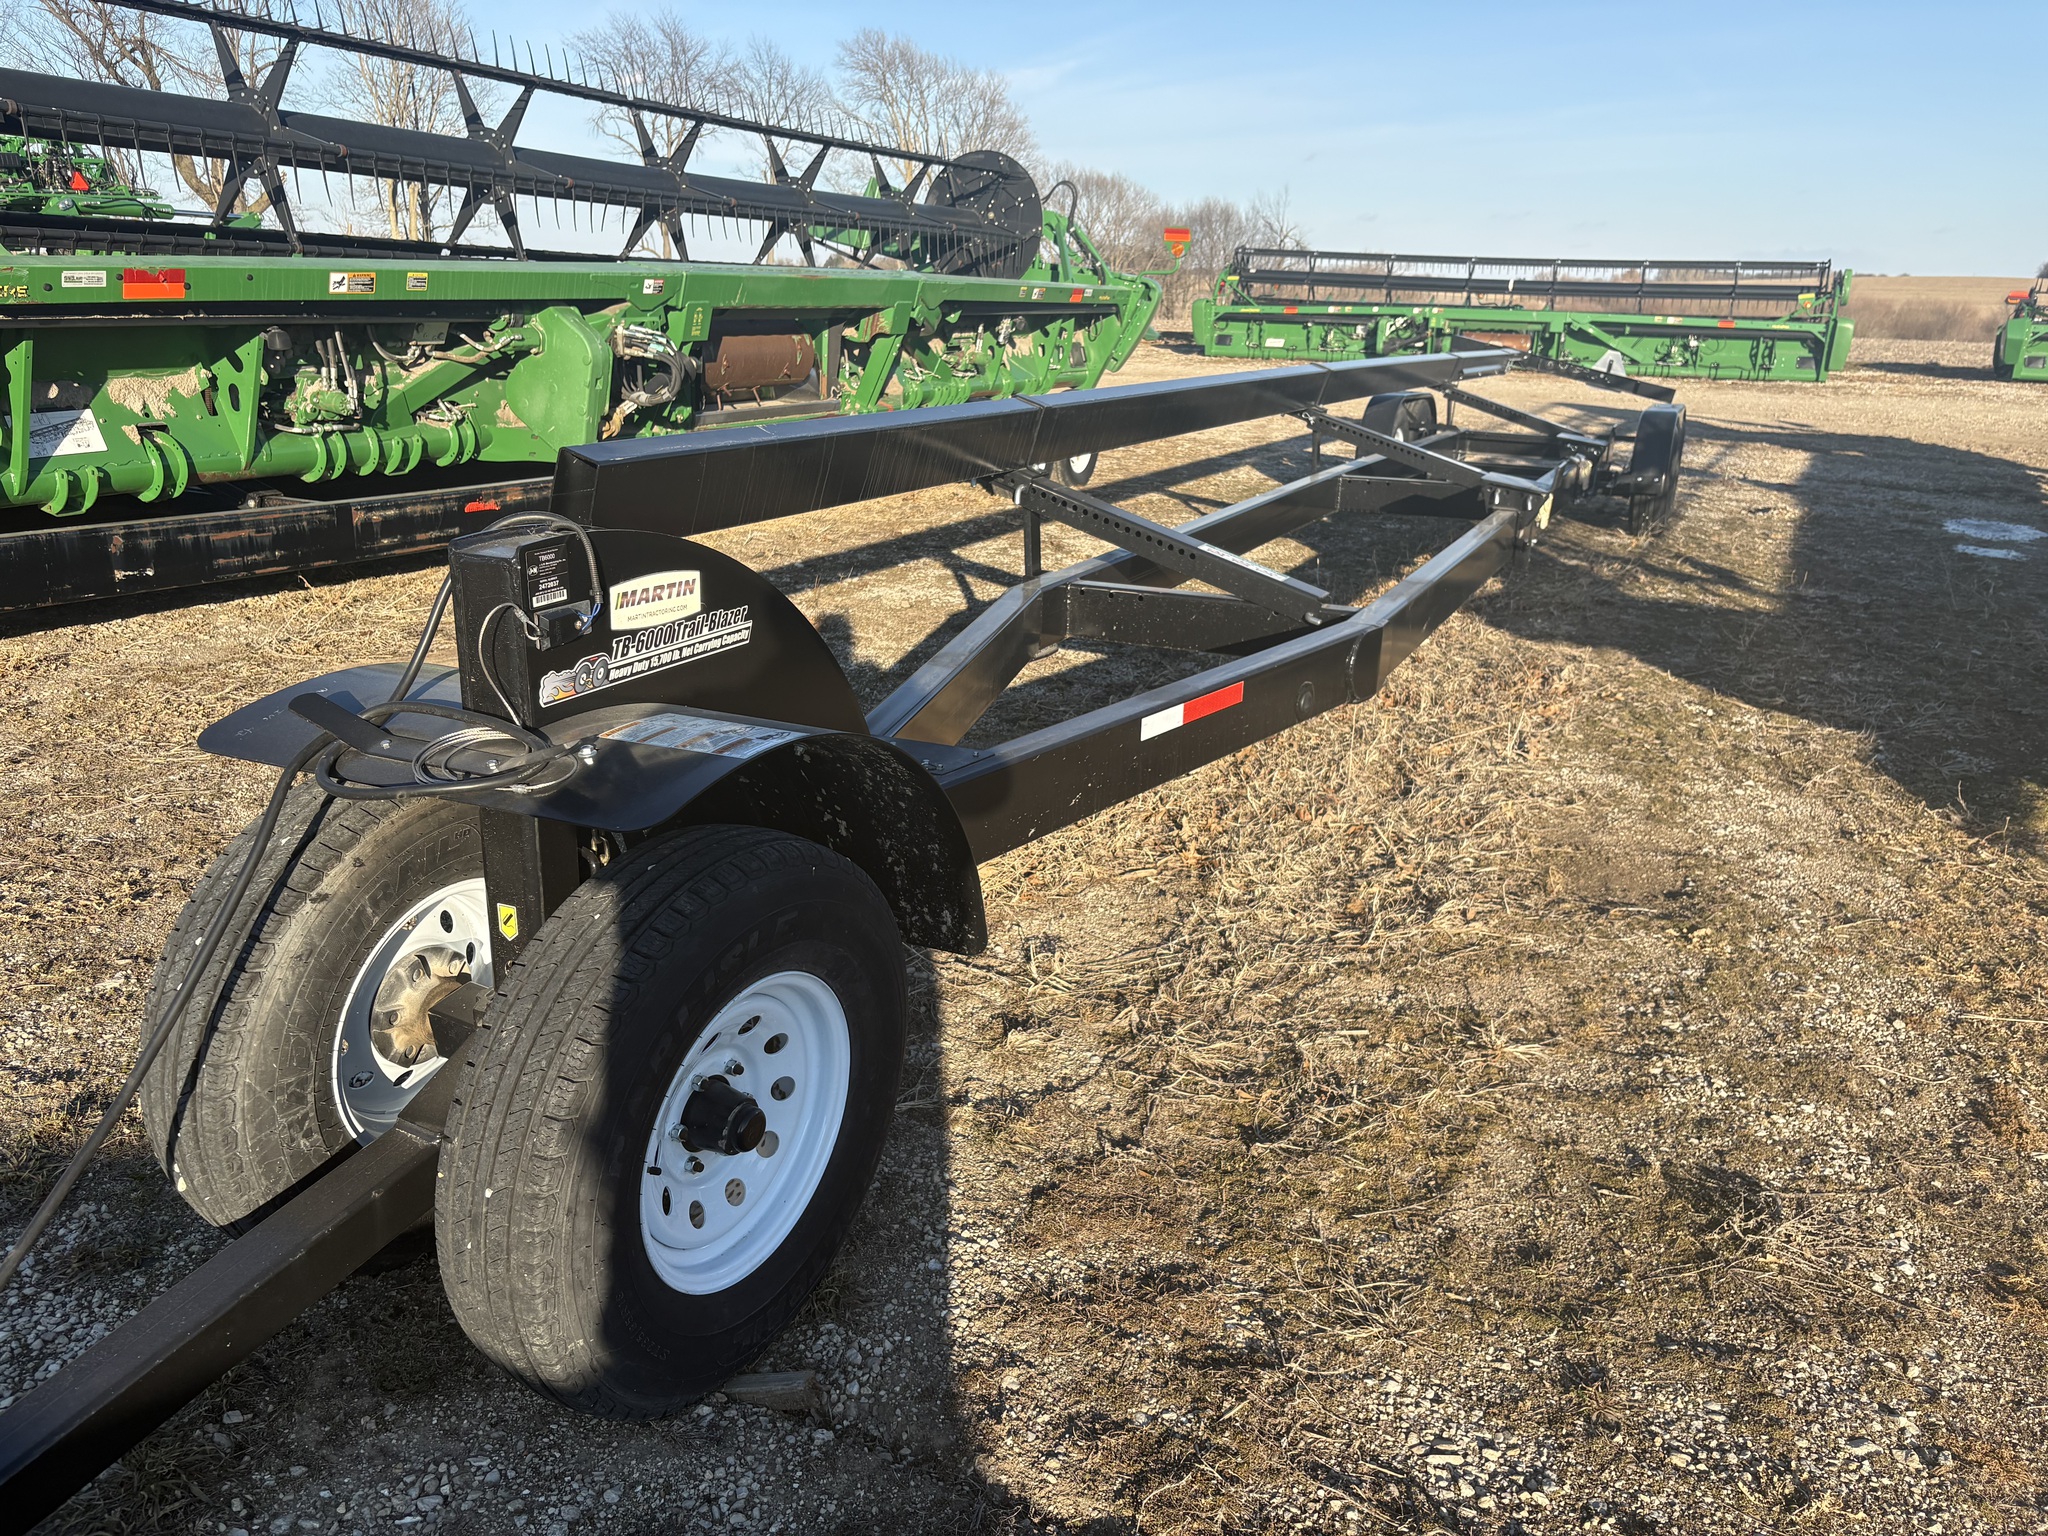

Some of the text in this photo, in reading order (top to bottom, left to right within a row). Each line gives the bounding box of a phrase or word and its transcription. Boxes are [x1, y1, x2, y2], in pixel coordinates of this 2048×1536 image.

[619, 578, 696, 609] MARTIN
[608, 666, 633, 681] Heavy
[632, 660, 650, 674] Duty
[650, 651, 673, 668] 15,700
[681, 647, 694, 659] Net
[693, 638, 722, 655] Carrying
[721, 628, 750, 646] Capacity
